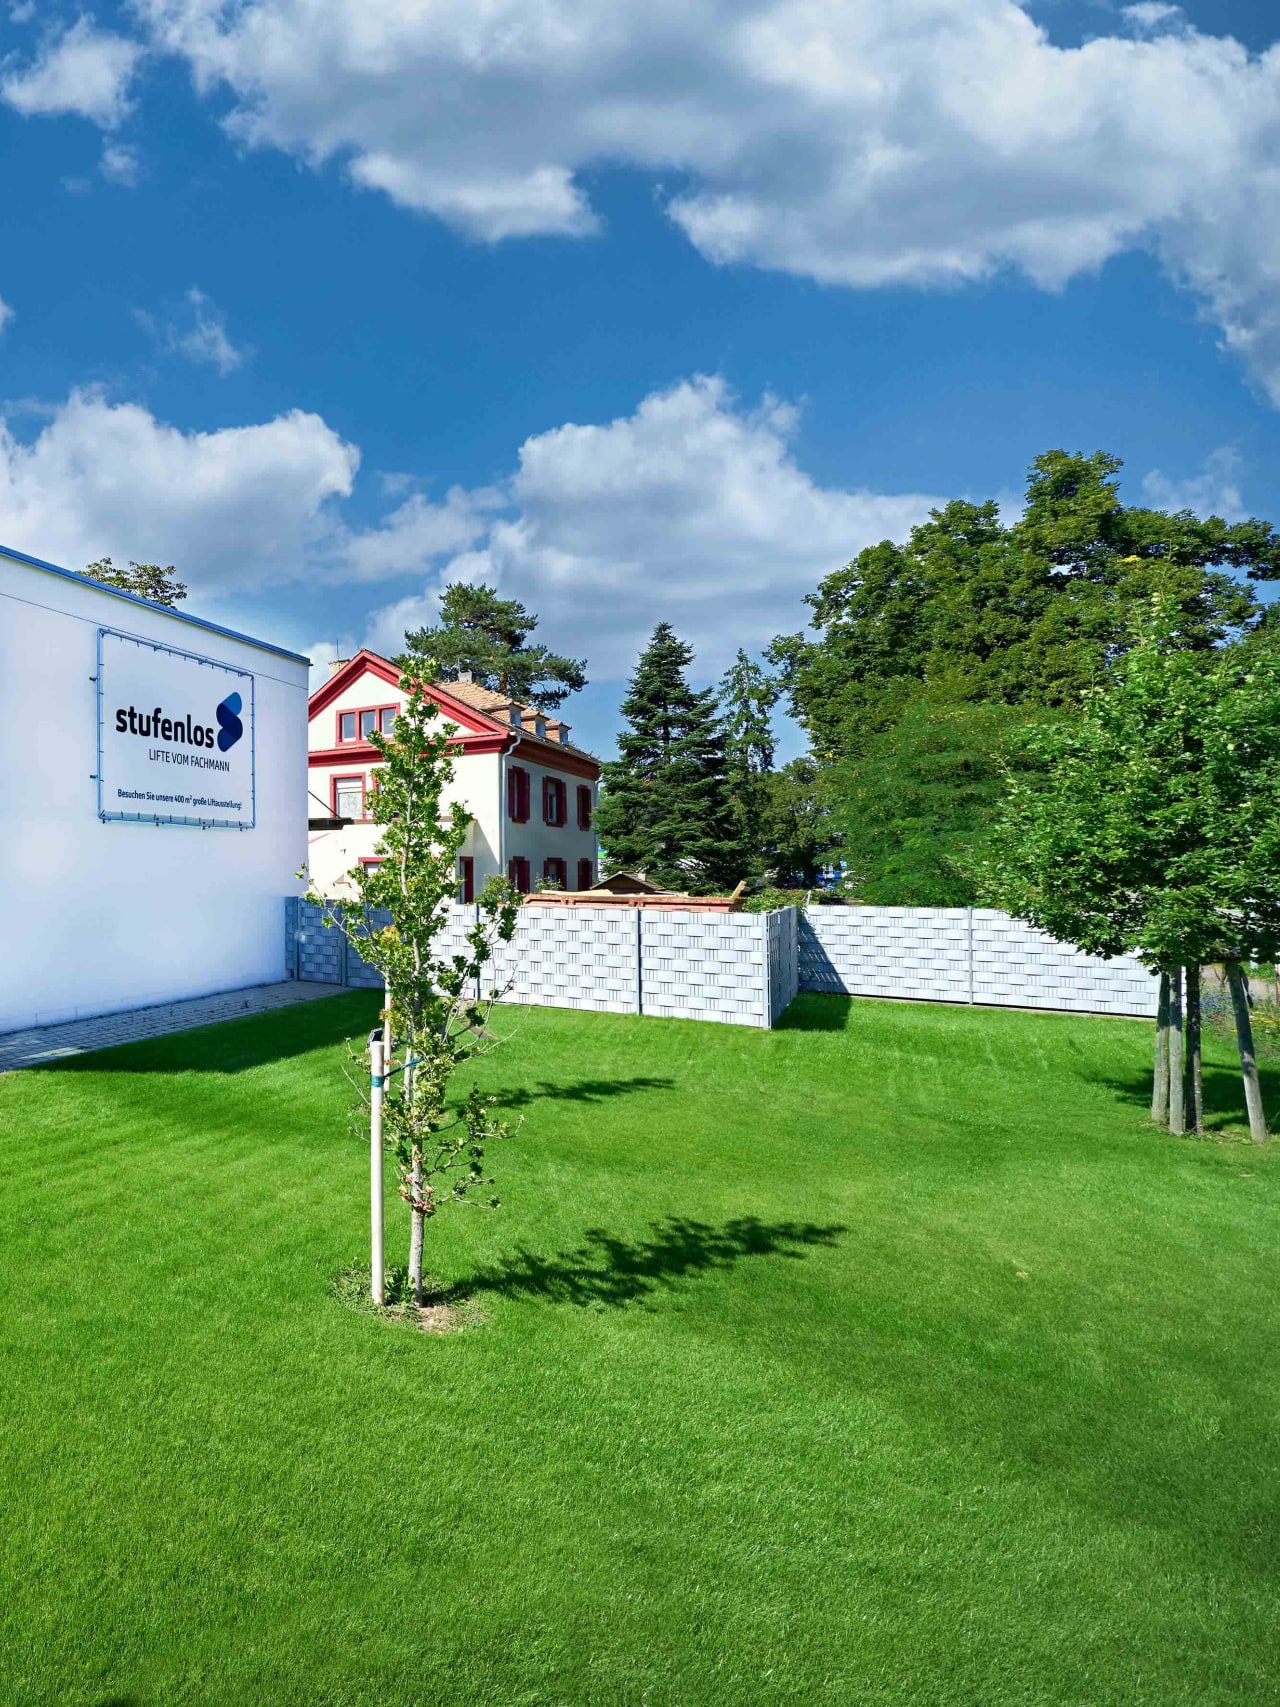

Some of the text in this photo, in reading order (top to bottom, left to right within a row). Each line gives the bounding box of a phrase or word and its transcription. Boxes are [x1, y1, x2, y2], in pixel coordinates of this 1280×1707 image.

[116, 706, 214, 748] stufenlos
[149, 749, 230, 773] LIFTE VOM FACHMANN
[117, 788, 146, 800] Besuchen
[146, 791, 155, 801] Sie
[155, 793, 174, 803] unsere
[174, 794, 185, 804] 400
